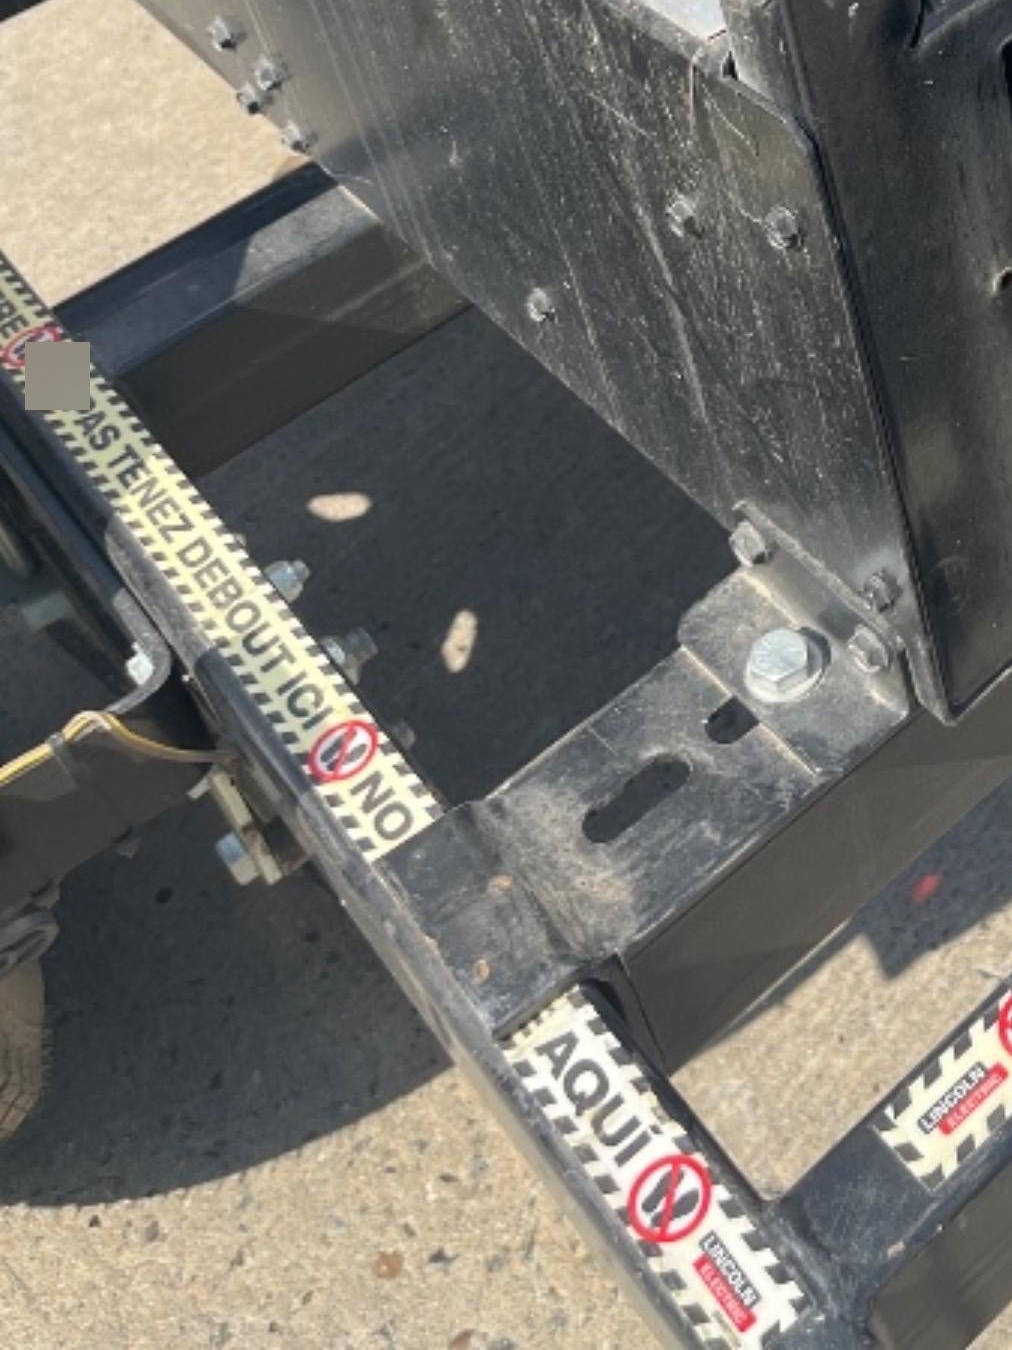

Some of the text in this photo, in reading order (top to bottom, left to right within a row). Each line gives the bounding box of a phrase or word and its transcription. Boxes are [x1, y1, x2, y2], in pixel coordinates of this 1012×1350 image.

[77, 398, 336, 737] AS TENEZ DEBOUT ICI
[349, 766, 415, 842] NO
[919, 1065, 986, 1132] LINCOLN
[943, 1067, 1004, 1130] ELECTRIC
[698, 1259, 752, 1326] ELECTRIC
[704, 1235, 758, 1307] LINCOLN
